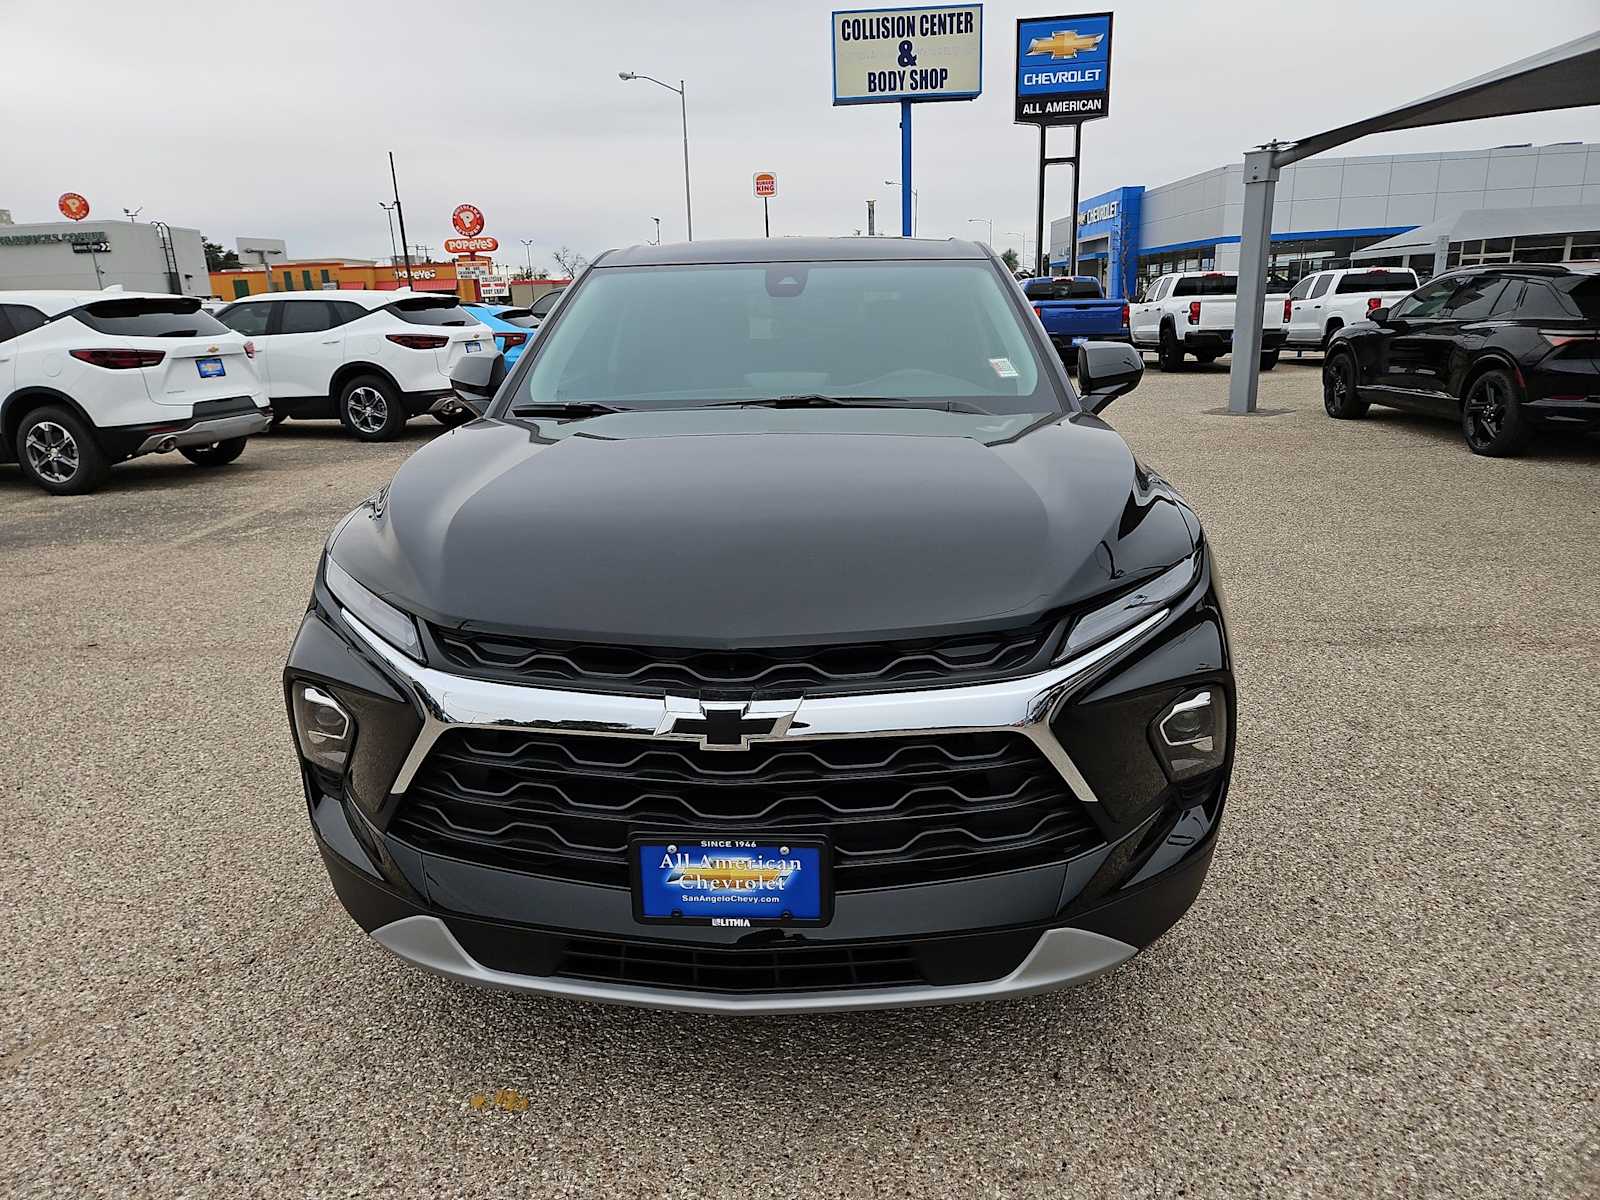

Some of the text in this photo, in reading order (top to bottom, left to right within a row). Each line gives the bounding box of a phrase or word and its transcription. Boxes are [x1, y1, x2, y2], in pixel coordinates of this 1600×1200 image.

[842, 12, 973, 41] COLLISION CENTER
[898, 40, 917, 67] &
[868, 69, 948, 92] BODY SHOP
[1024, 69, 1102, 86] CHEVROLET
[1023, 99, 1102, 115] ALL AMERICAN
[1087, 201, 1119, 224] CHEVROLET
[701, 840, 732, 848] SINCE
[659, 853, 802, 871] All American
[680, 874, 785, 891] Chevrolet
[681, 894, 780, 904] SanAngeloChevy.com
